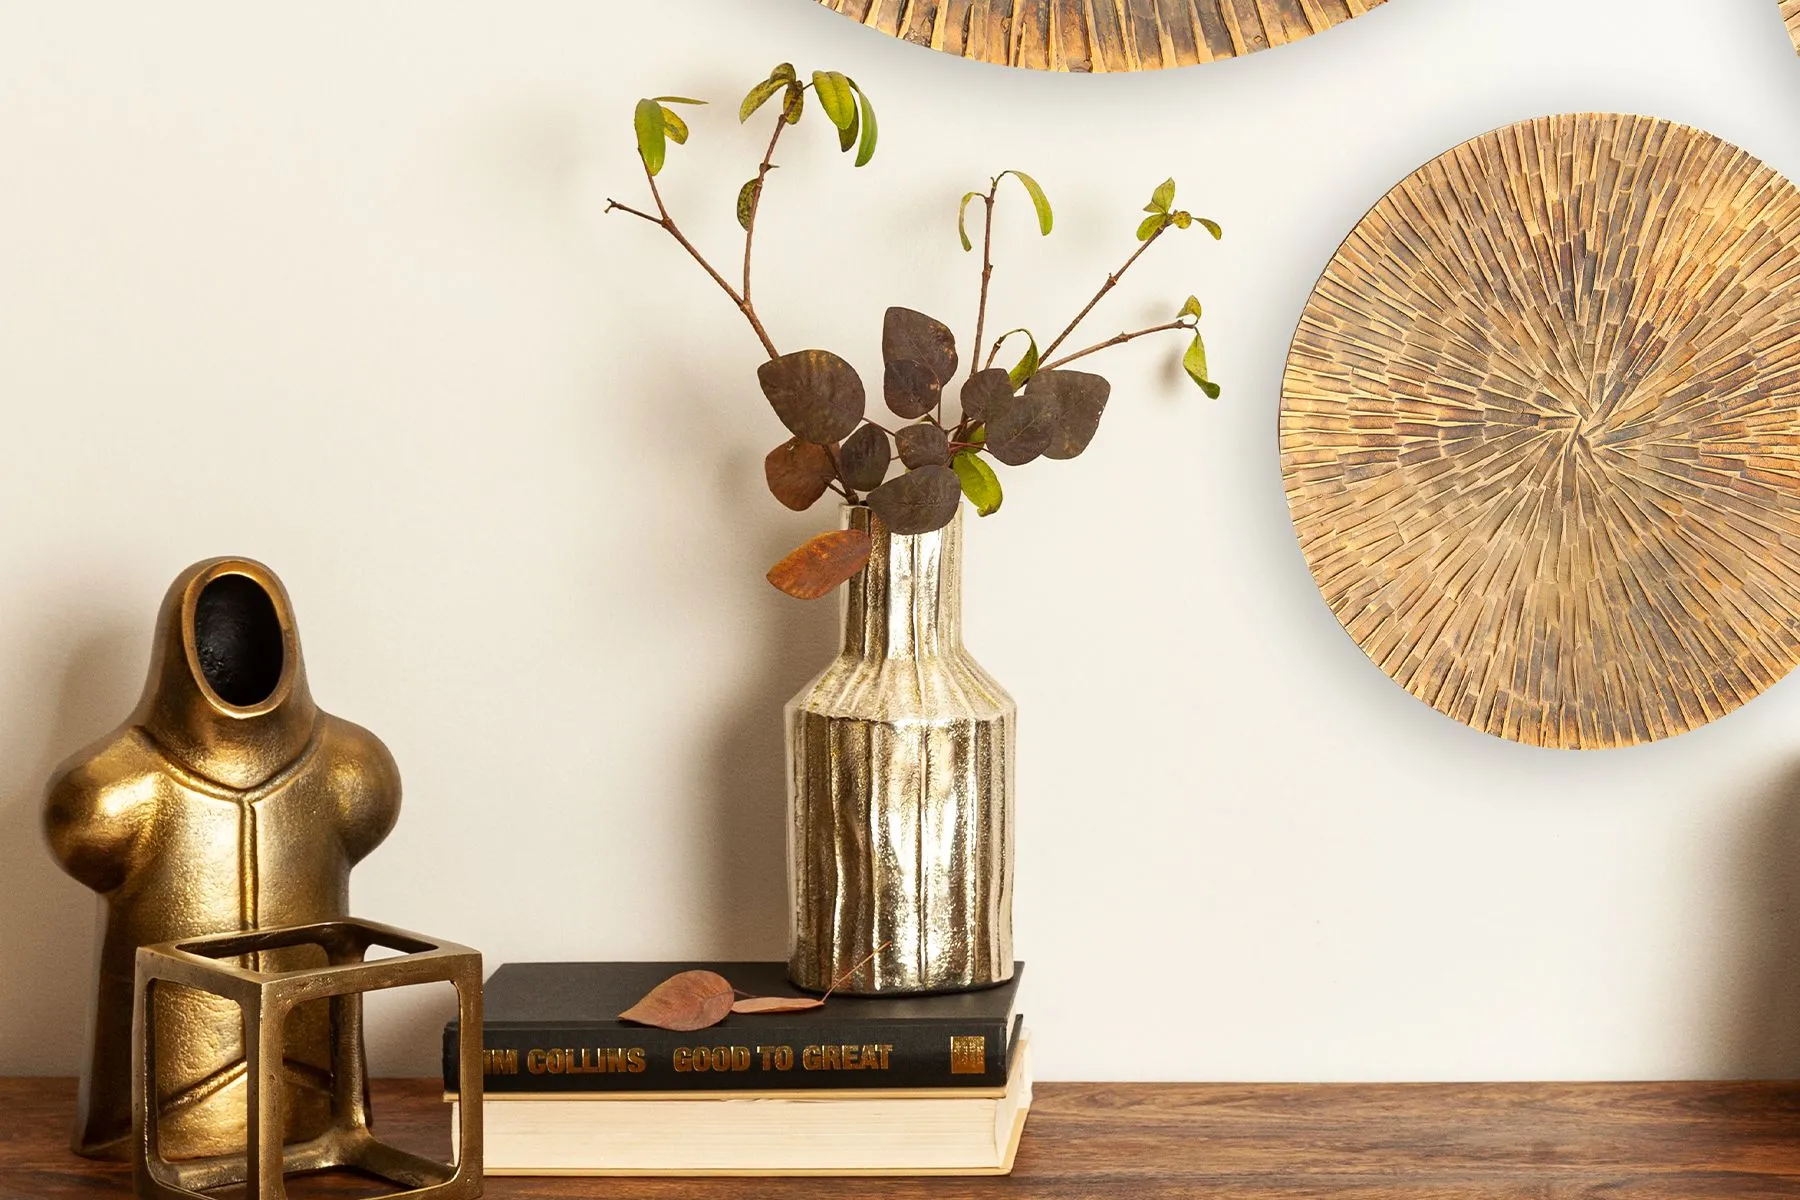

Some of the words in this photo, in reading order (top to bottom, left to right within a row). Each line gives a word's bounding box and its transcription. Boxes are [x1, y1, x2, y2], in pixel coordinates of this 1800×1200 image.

[483, 1049, 518, 1074] IM
[527, 1048, 646, 1074] COLLINS
[672, 1046, 751, 1072] GOOD
[757, 1045, 794, 1071] TO
[802, 1043, 893, 1071] GREAT
